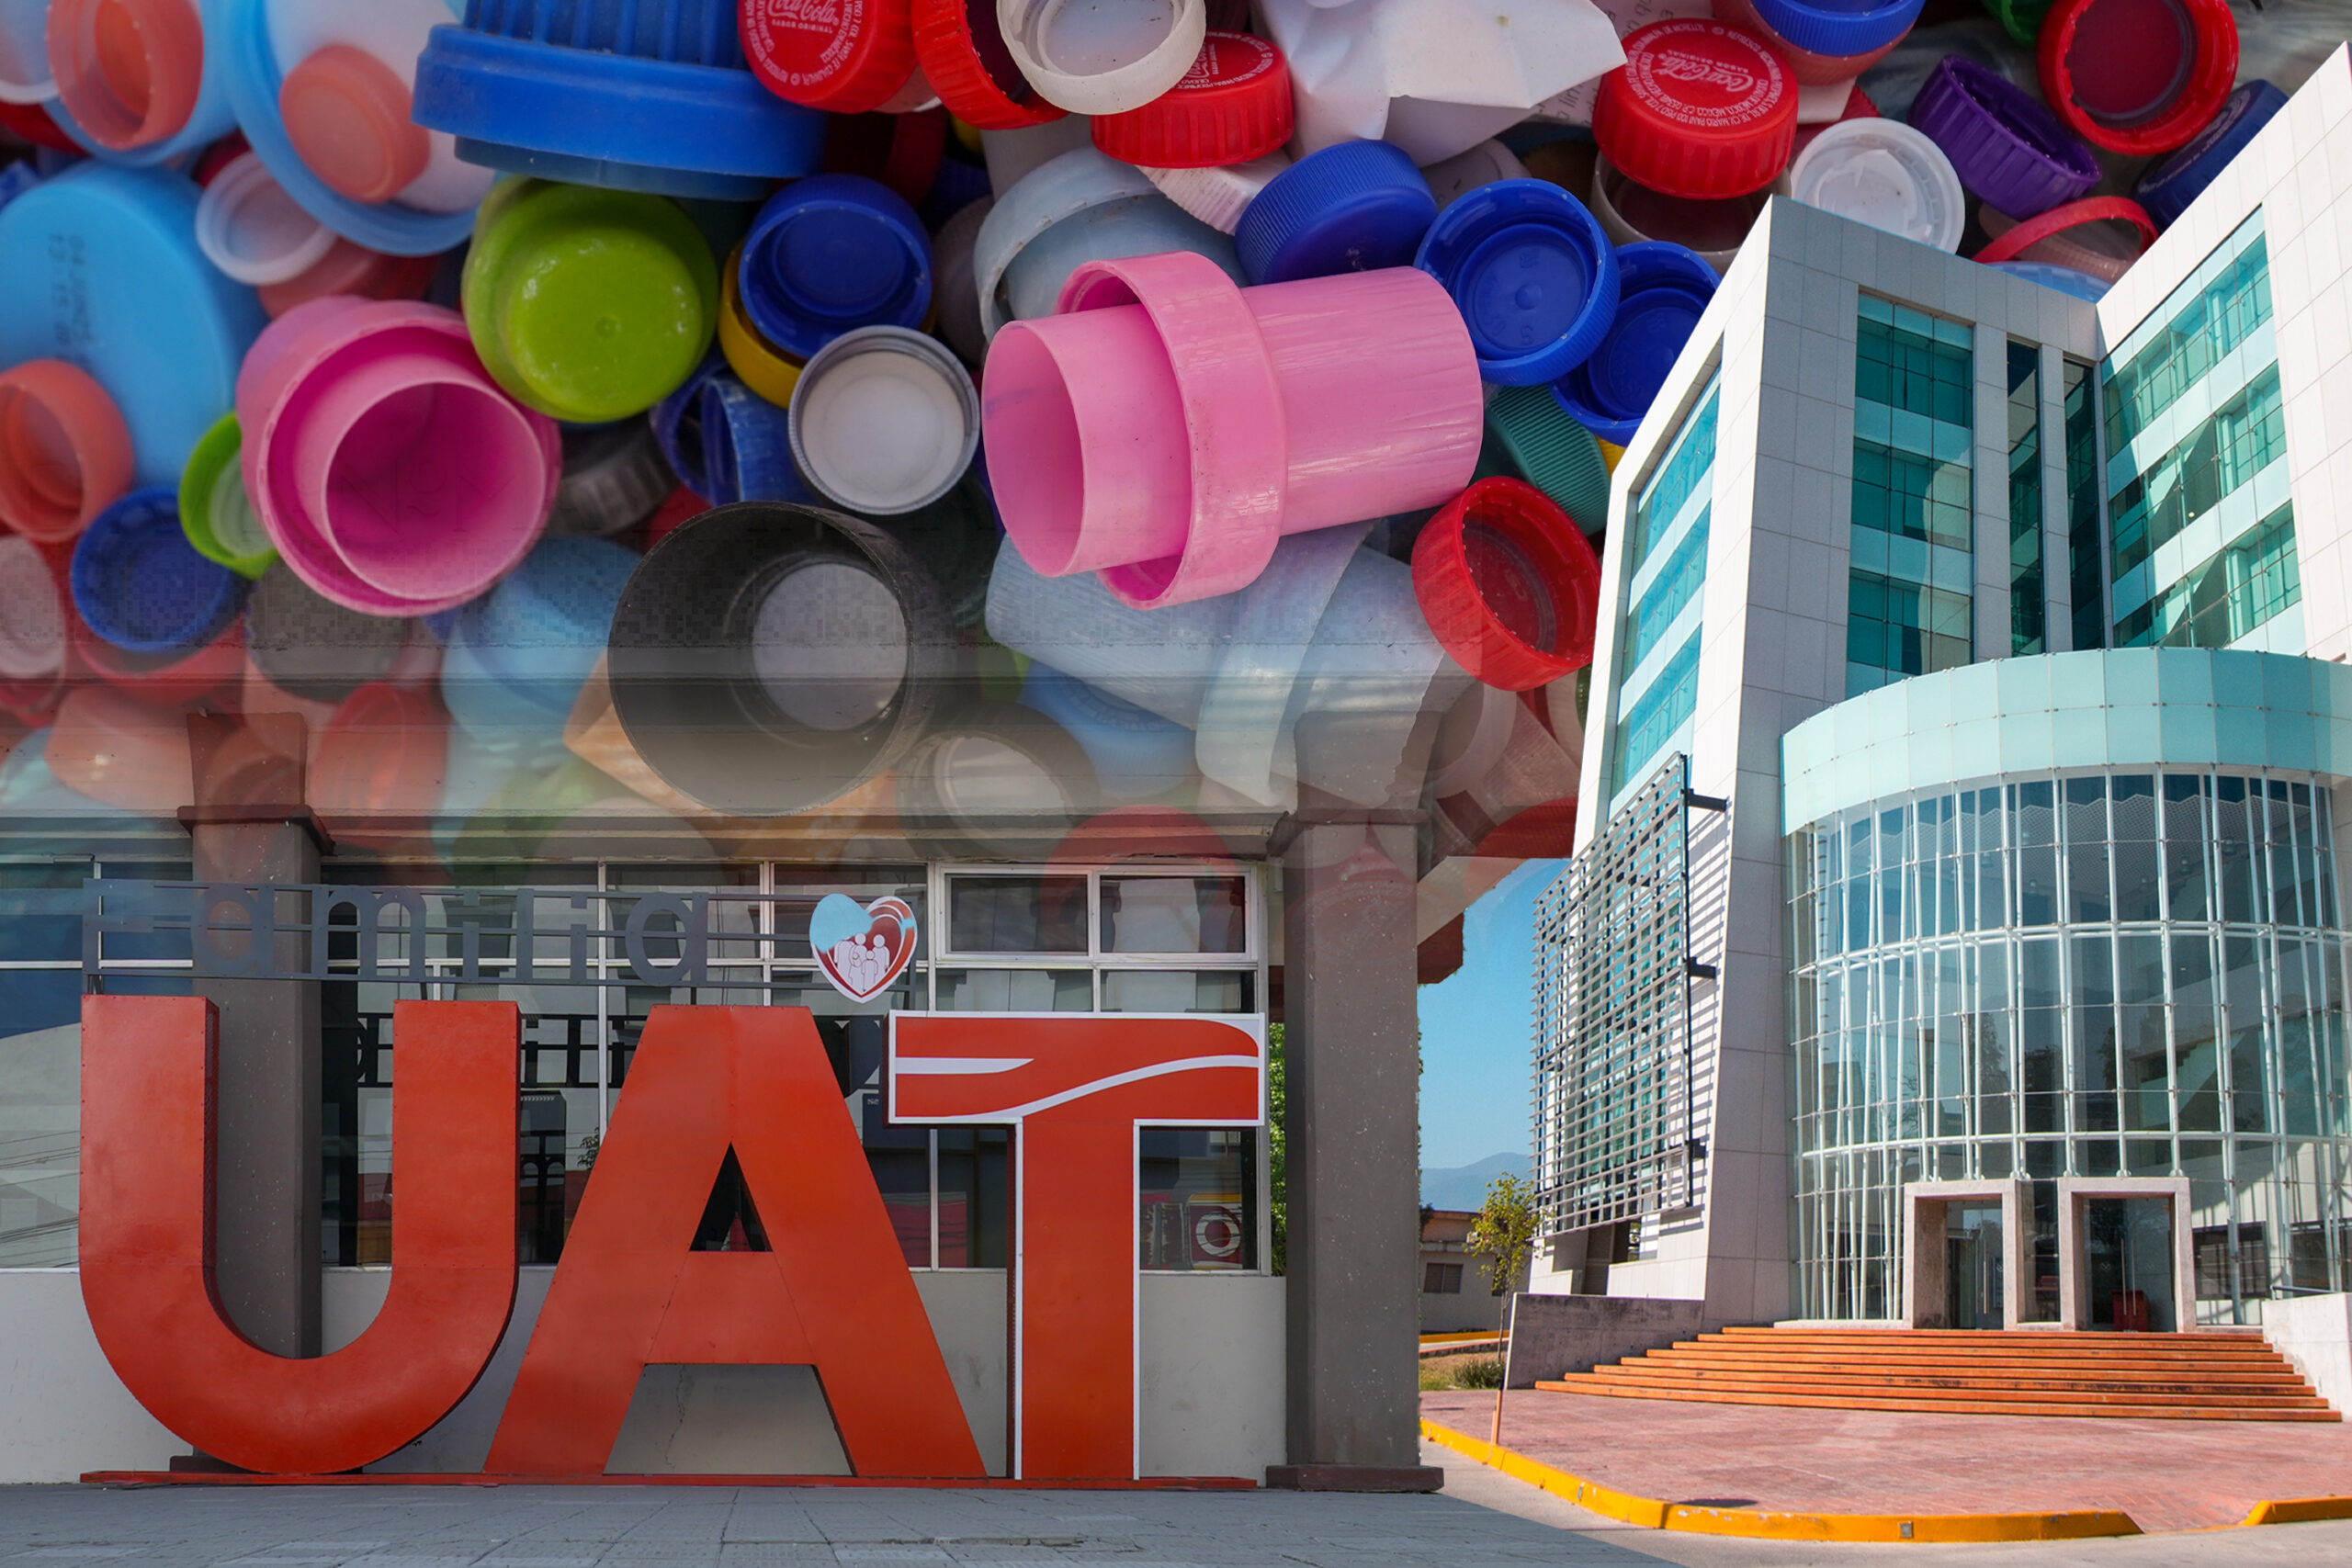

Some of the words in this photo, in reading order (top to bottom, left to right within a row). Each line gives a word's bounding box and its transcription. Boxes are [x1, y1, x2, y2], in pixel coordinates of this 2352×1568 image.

[797, 22, 833, 34] ORIGINAL
[1668, 50, 1714, 64] ORIGINAL
[1717, 60, 1749, 73] SABOR
[1652, 57, 1754, 92] Coca-Cola
[80, 993, 1266, 1481] UAT
